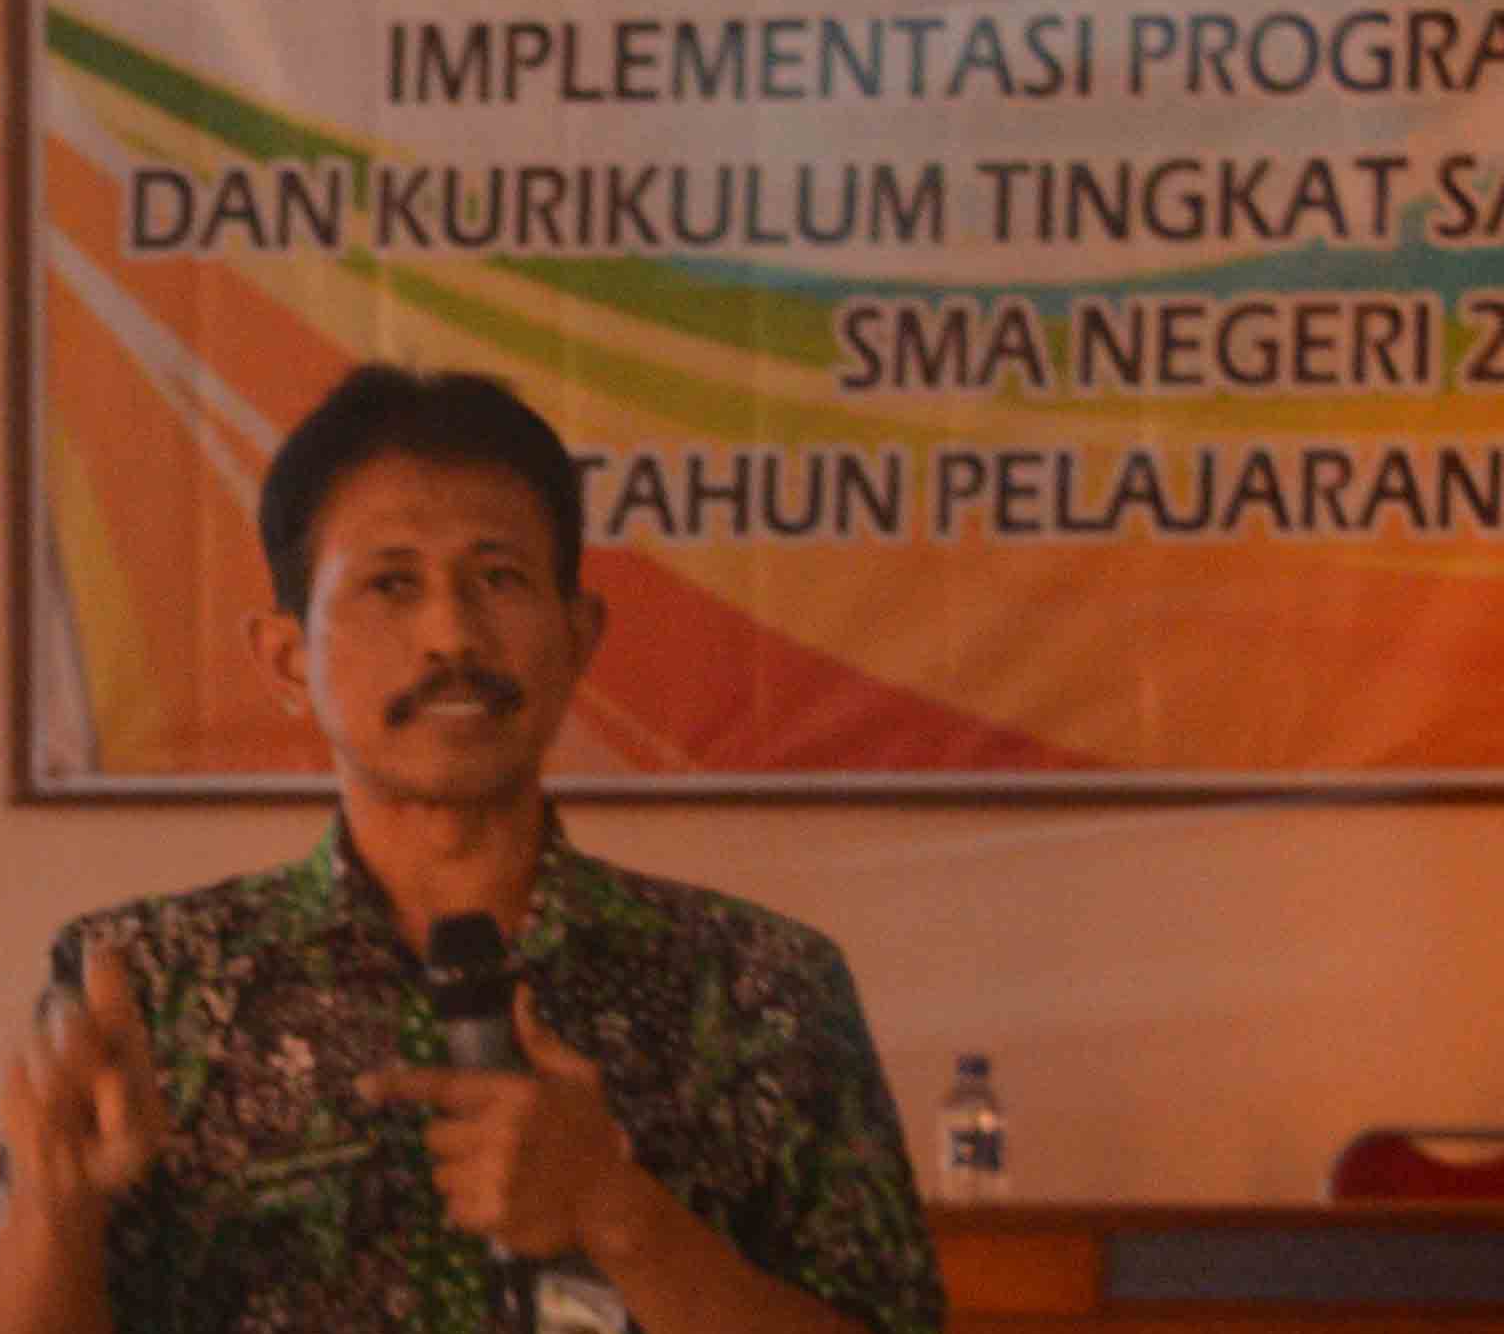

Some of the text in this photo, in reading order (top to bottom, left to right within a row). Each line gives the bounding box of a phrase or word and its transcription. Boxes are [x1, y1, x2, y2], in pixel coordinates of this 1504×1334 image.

[389, 11, 1095, 105] IMPLEMENTASI
[129, 167, 342, 252] DAN
[379, 162, 947, 250] KURIKULUM
[975, 155, 1409, 243] TINGKAT
[839, 302, 1047, 390] SMA
[1077, 299, 1431, 387] NEGERI
